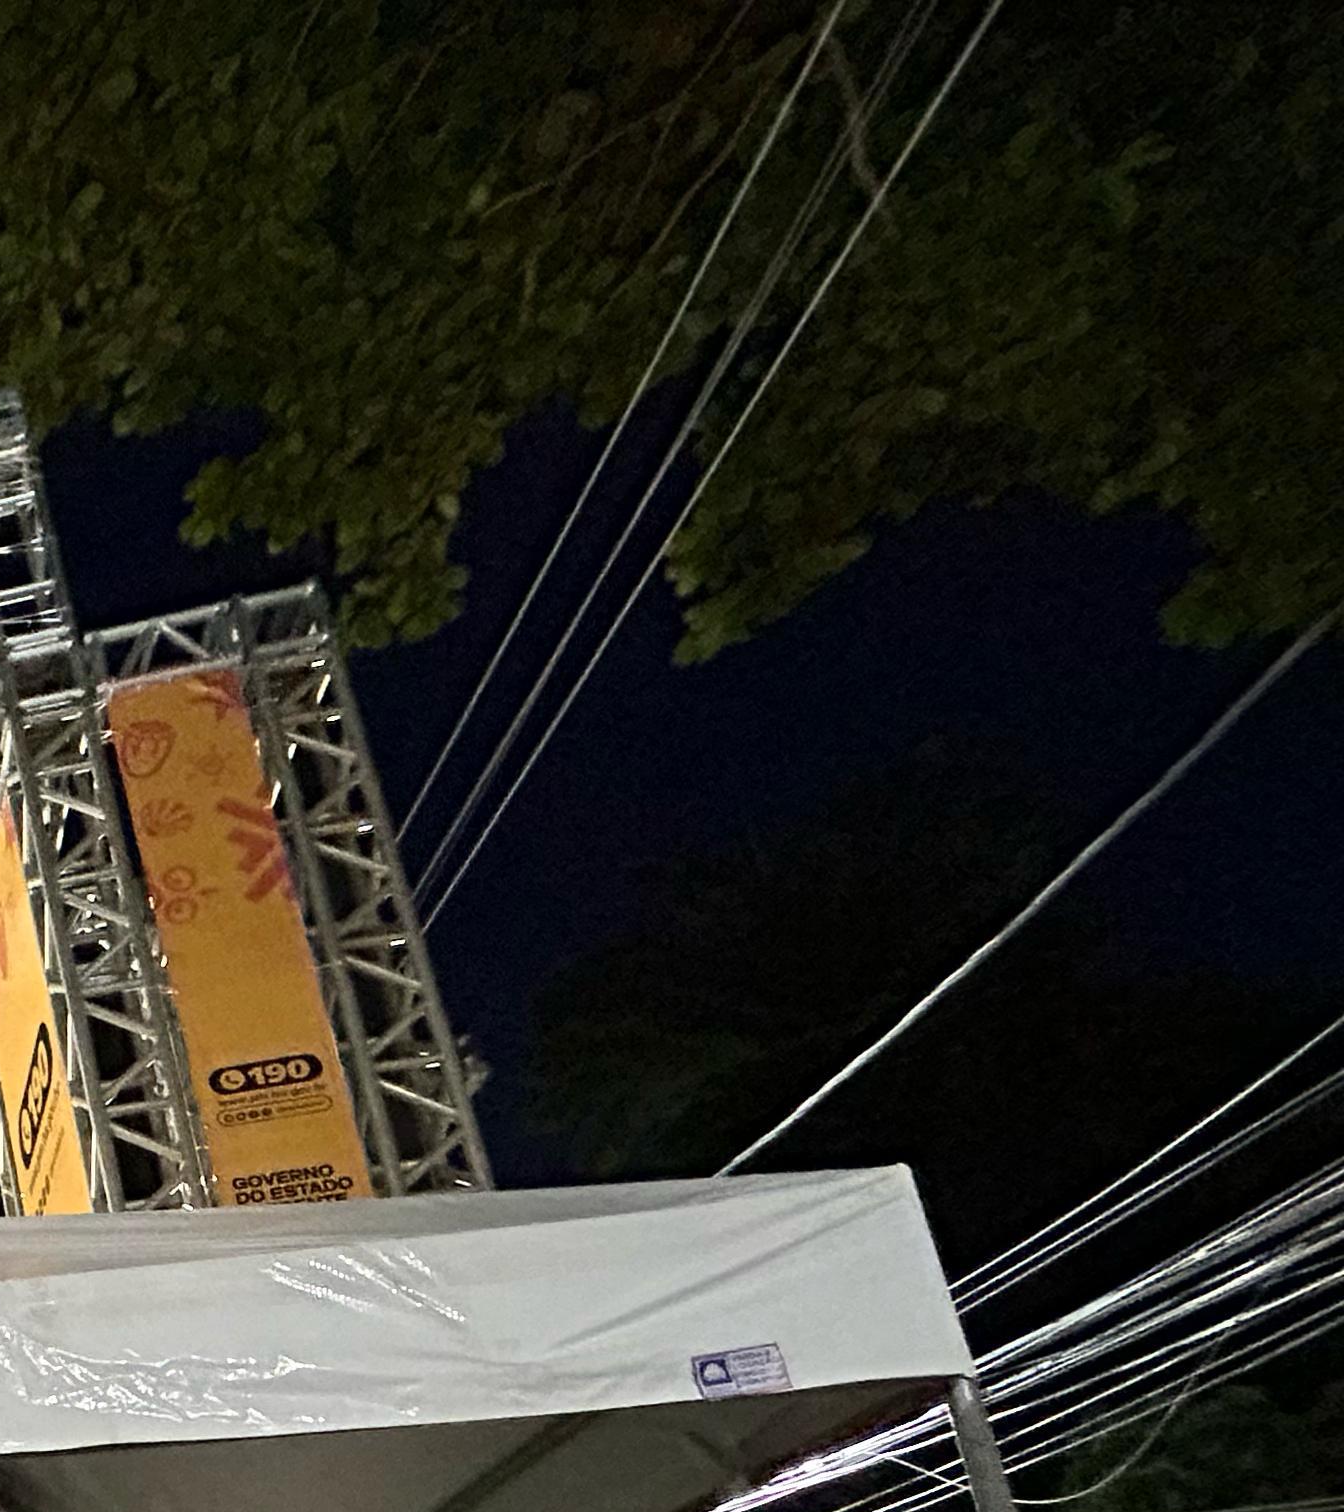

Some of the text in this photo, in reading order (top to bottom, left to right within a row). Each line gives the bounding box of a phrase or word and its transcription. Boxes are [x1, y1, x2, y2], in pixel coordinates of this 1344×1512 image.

[247, 1058, 311, 1086] 190
[232, 1164, 334, 1190] GOVERNO
[235, 1189, 266, 1205] DO
[269, 1176, 354, 1201] ESTADO
